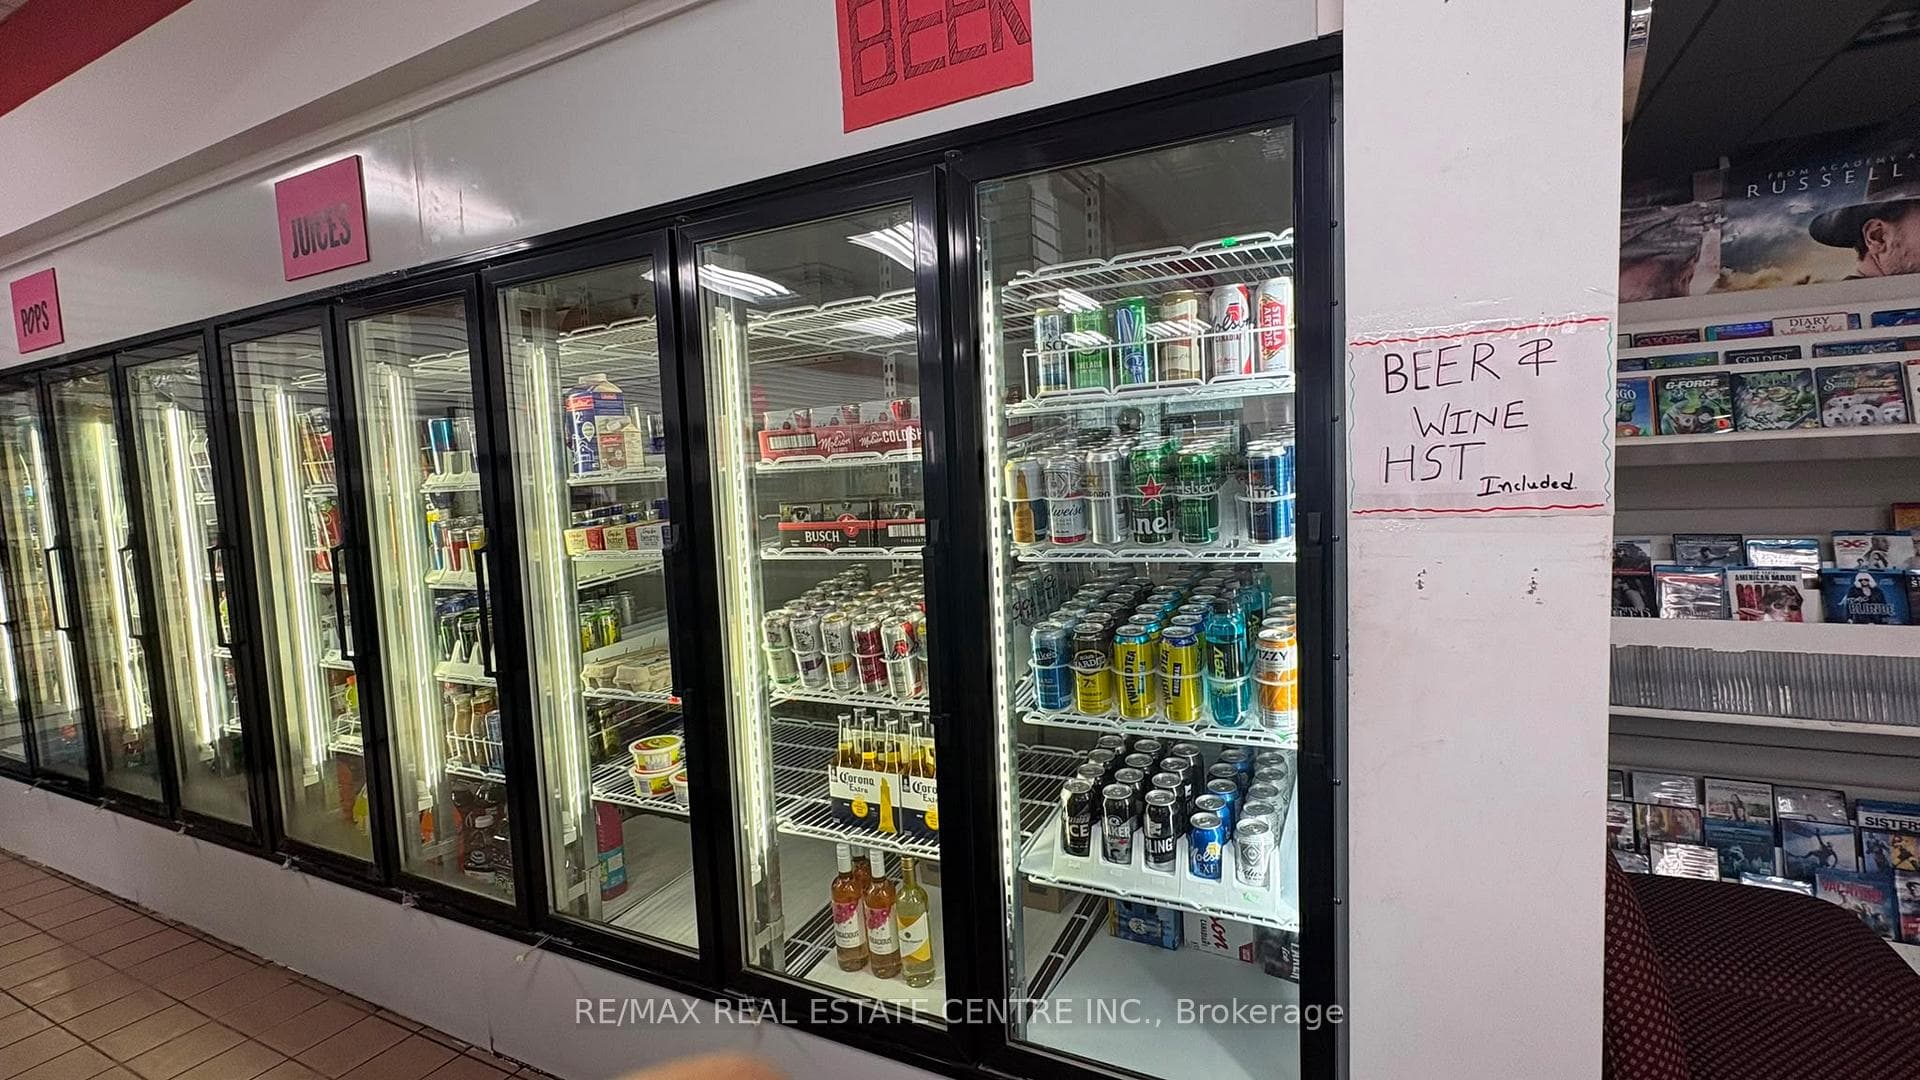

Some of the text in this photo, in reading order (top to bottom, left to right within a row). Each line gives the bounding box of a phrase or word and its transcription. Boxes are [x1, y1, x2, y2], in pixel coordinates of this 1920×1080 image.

[1747, 162, 1903, 198] RUSSELL
[290, 200, 353, 259] JUICES
[20, 300, 50, 338] POPS
[1272, 305, 1282, 347] STELA
[1789, 315, 1830, 328] DIARY
[1384, 344, 1501, 395] BEER
[1665, 378, 1720, 391] G-FORCE
[883, 429, 908, 443] COLD
[1412, 400, 1529, 438] WINE
[1383, 441, 1487, 484] HST
[805, 530, 840, 543] BUSCH
[1125, 667, 1139, 705] TWISTD
[839, 772, 875, 787] Corona
[849, 784, 869, 794] Extra
